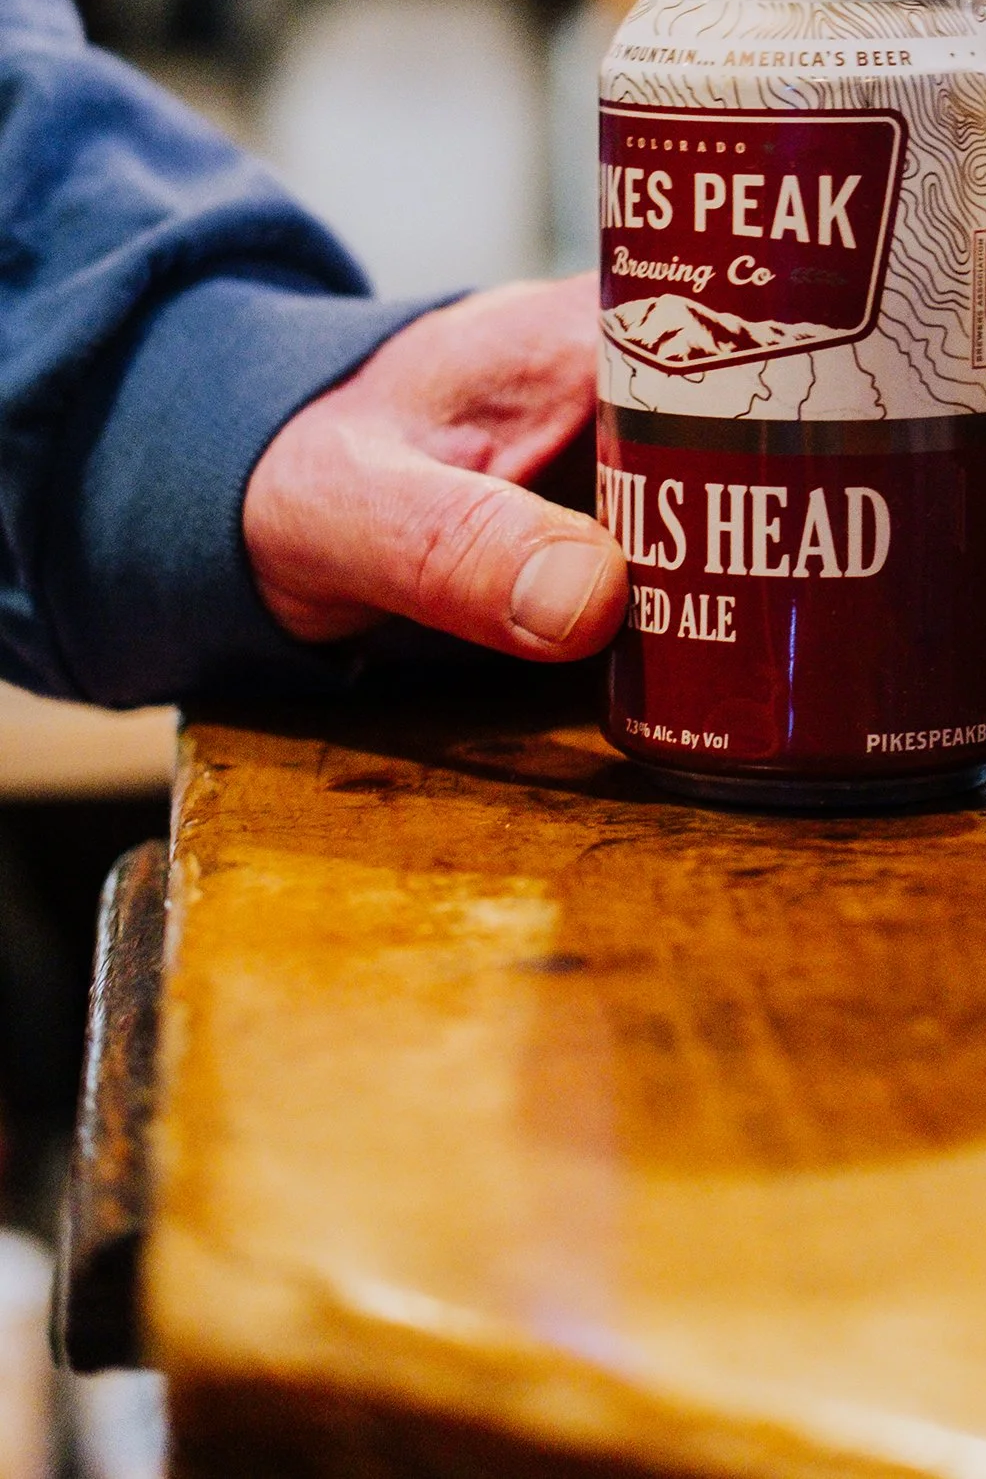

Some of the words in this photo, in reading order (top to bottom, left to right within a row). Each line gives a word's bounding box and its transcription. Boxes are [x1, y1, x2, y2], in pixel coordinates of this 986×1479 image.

[723, 50, 846, 67] AMERICA'S
[856, 50, 912, 67] BEER
[626, 136, 747, 154] COLORADO
[599, 162, 674, 230] IKES
[694, 172, 862, 250] PEAK
[611, 245, 716, 294] Brewing
[727, 254, 776, 286] Co
[704, 483, 891, 578] HEAD
[677, 593, 736, 643] ALE
[626, 718, 651, 738] 7.3%
[652, 725, 677, 744] Alc.
[681, 729, 700, 750] By
[703, 732, 729, 750] Vol
